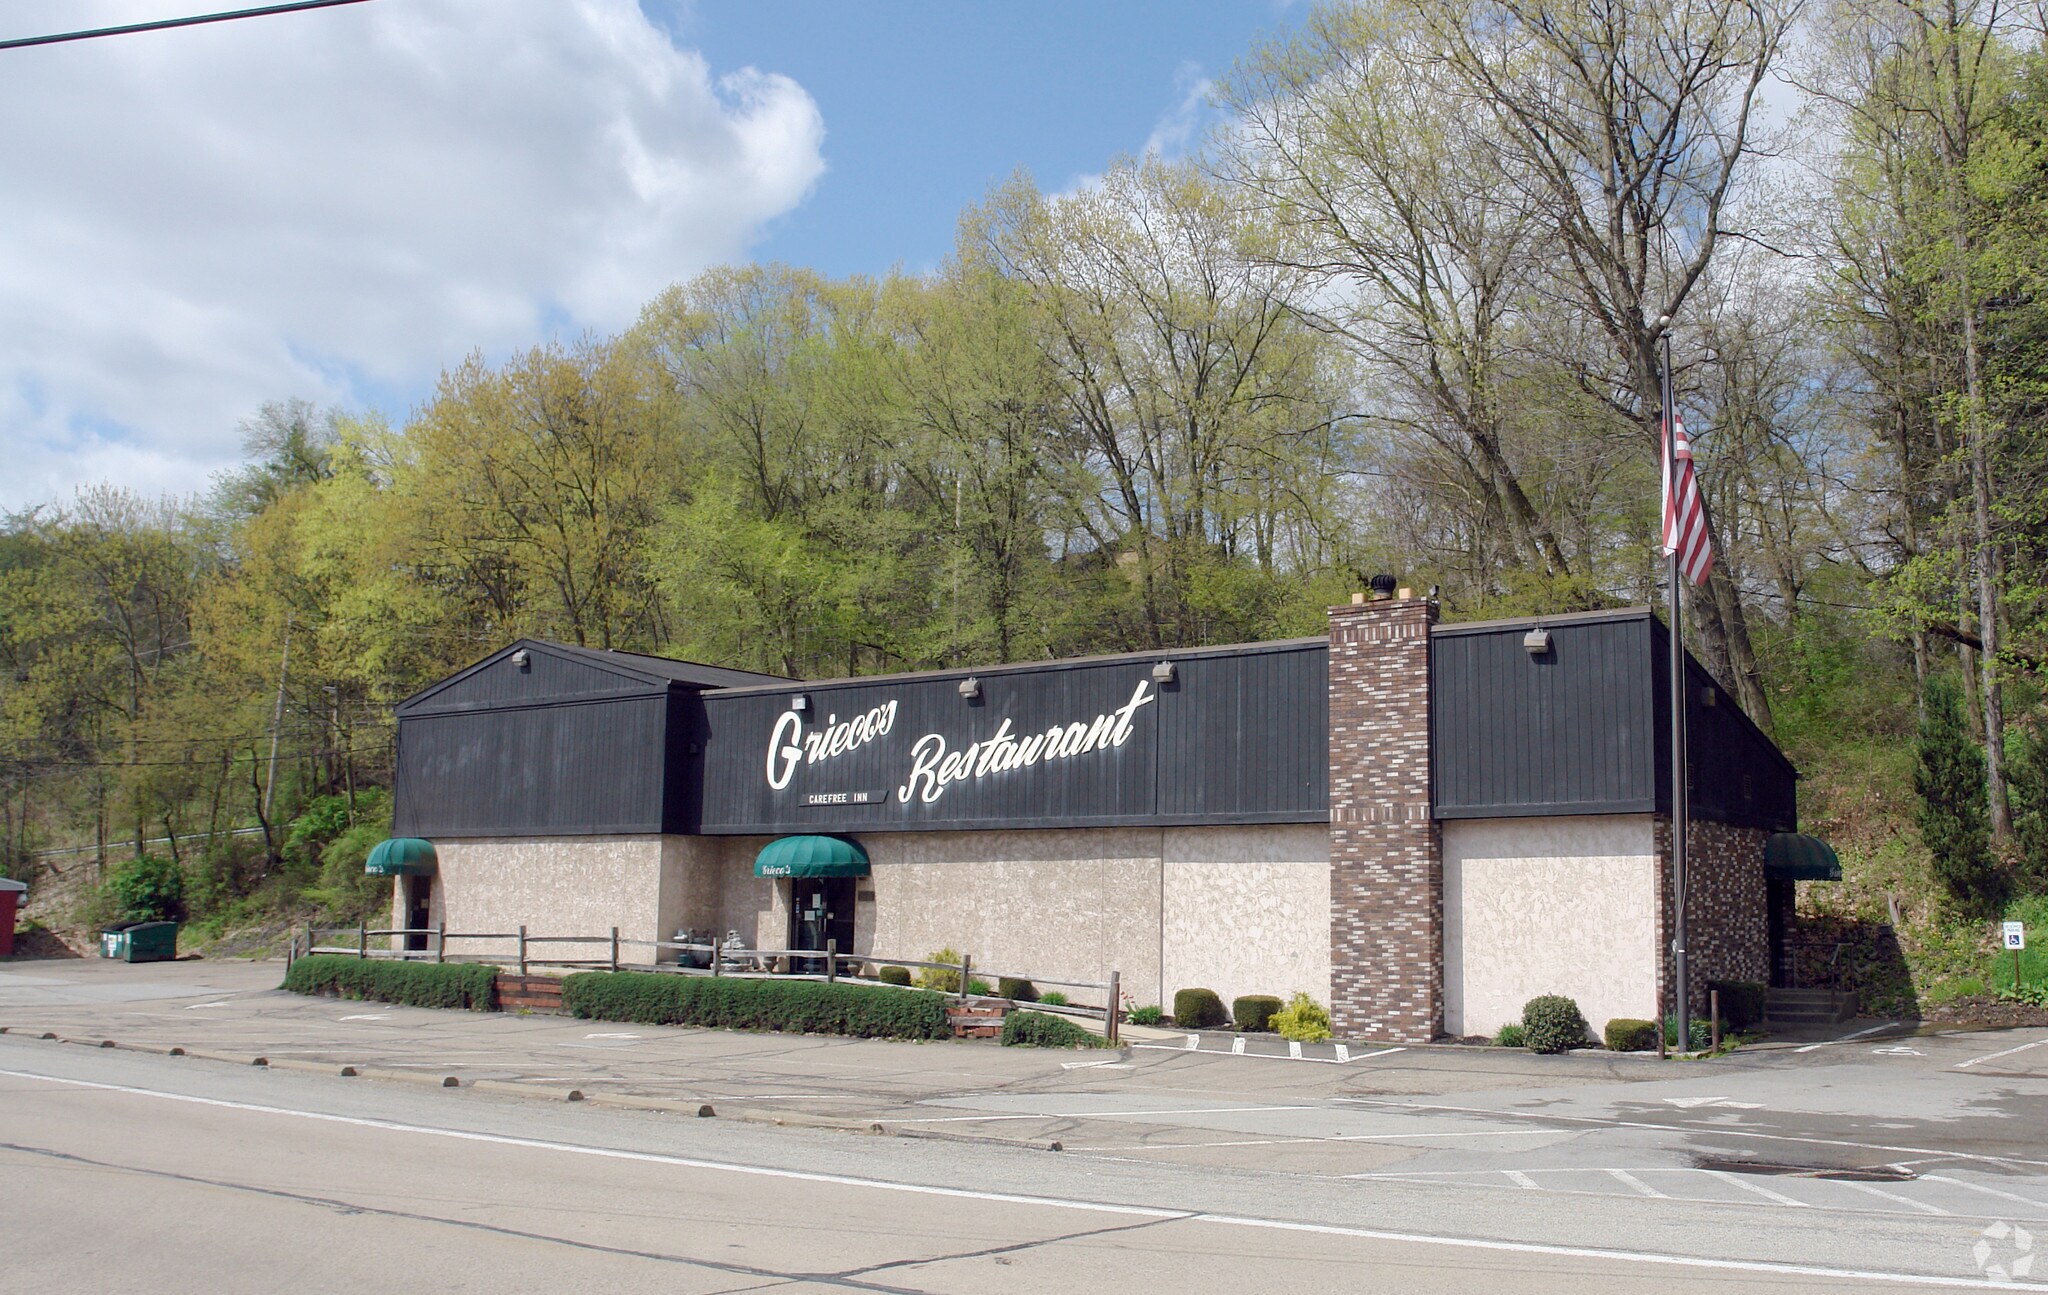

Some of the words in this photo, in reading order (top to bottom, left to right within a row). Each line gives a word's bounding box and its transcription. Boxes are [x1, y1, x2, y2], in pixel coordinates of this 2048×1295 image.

[766, 700, 898, 790] Grieco's
[898, 680, 1154, 803] Restaurant
[808, 793, 847, 804] CAREFREE
[853, 792, 868, 802] INN
